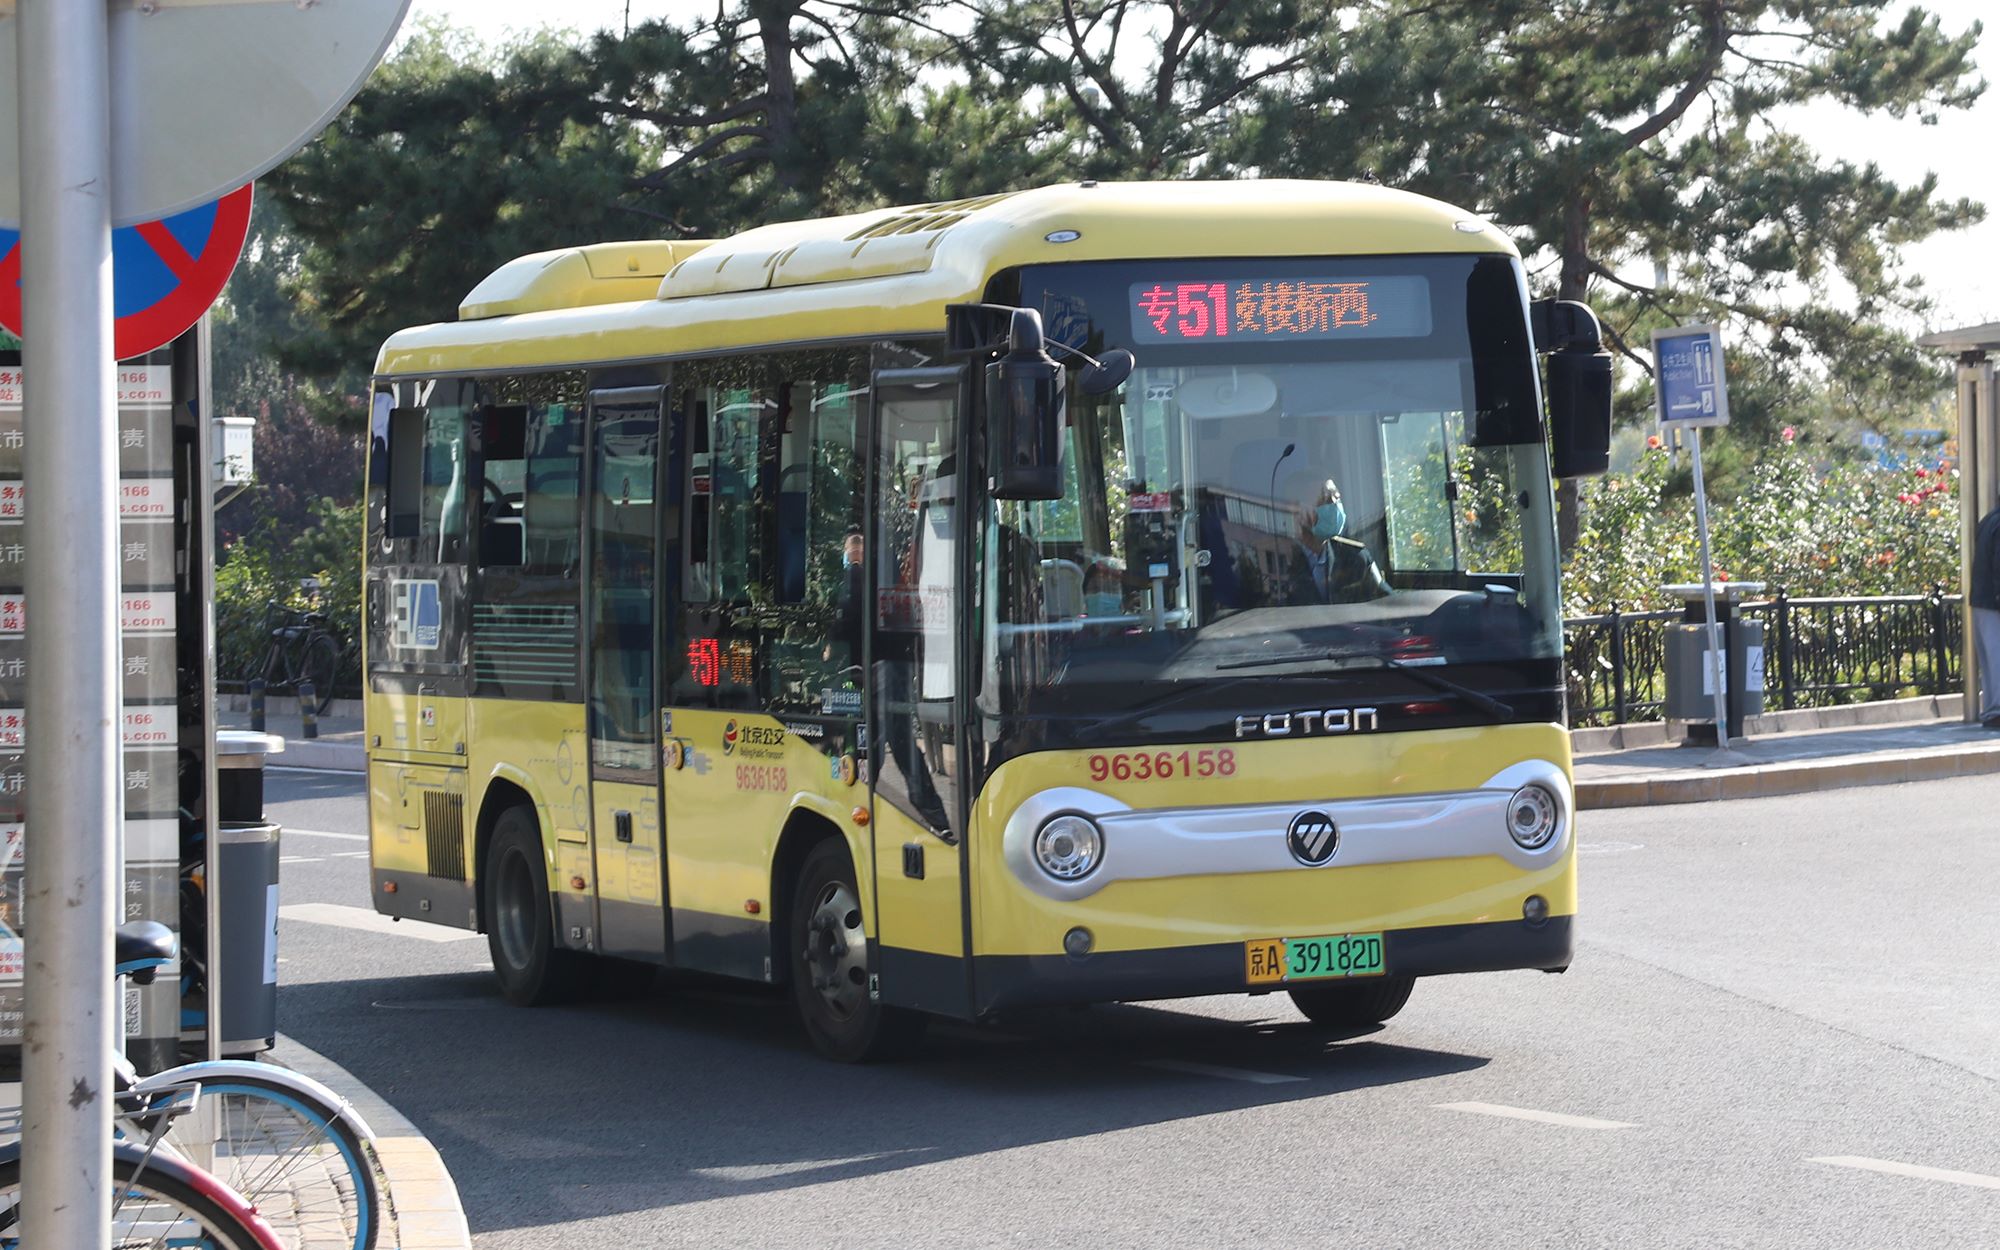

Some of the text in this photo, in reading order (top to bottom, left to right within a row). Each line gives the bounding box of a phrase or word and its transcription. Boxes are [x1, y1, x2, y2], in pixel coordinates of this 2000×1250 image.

[118, 373, 147, 383] 166
[120, 486, 149, 496] 166
[122, 600, 151, 610] 166
[123, 714, 152, 724] 166
[1235, 707, 1378, 737] FOTON
[740, 726, 785, 745] 北京公交
[1089, 749, 1236, 782] 9636158
[736, 765, 787, 792] 9636158
[1250, 938, 1382, 976] 京A 39182D
